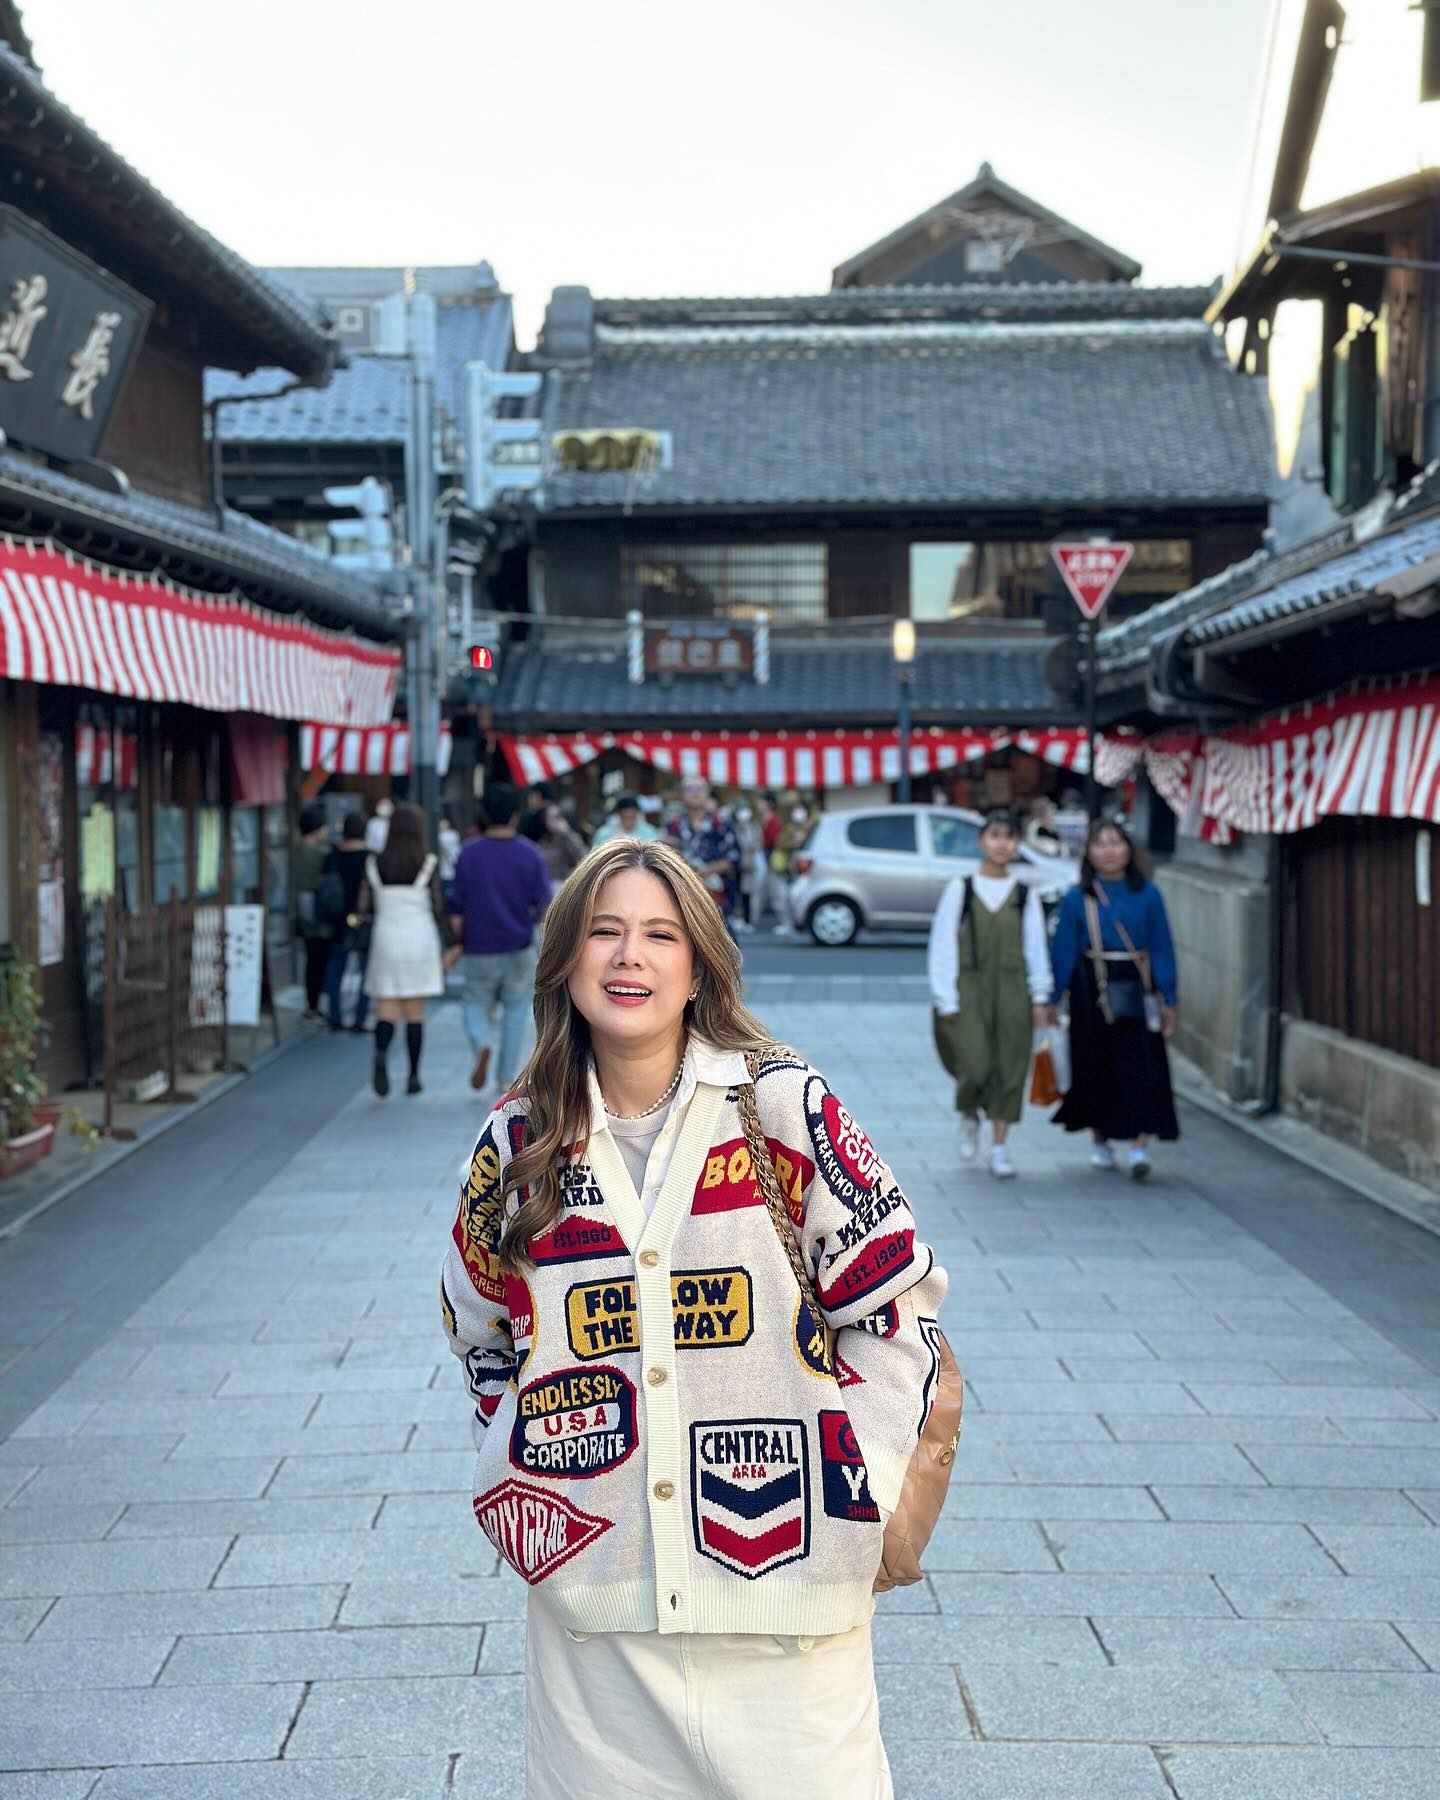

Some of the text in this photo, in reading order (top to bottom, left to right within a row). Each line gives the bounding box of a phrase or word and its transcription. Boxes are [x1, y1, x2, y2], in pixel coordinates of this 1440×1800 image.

[583, 1309, 738, 1350] THE WAY
[521, 1375, 623, 1416] ENDLESSLY
[523, 1433, 626, 1469] CORPORATE
[700, 1430, 799, 1465] CENTRAL
[732, 1464, 767, 1479] AREA
